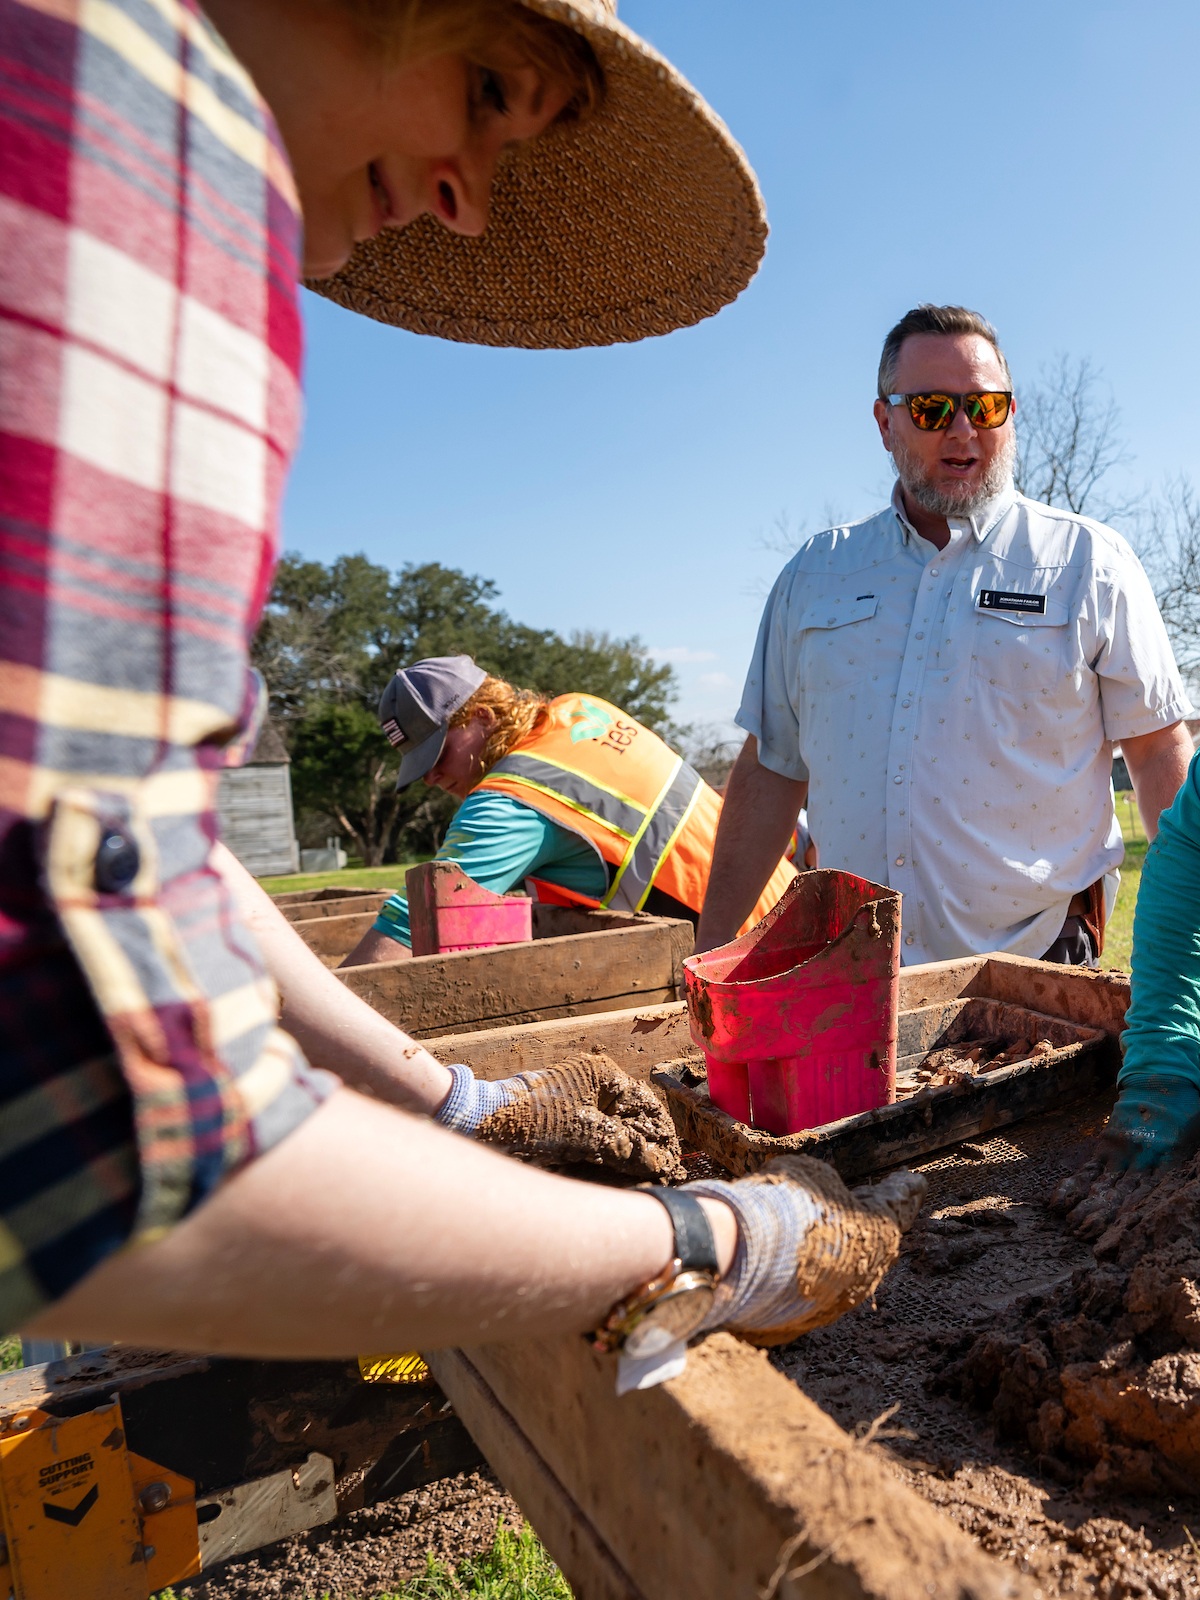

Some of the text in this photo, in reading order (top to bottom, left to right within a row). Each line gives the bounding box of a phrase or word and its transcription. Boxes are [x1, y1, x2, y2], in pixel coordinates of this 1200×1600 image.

[592, 720, 638, 756] ies
[38, 1460, 95, 1488] SUPPORT
[39, 1452, 91, 1477] CUTTING
